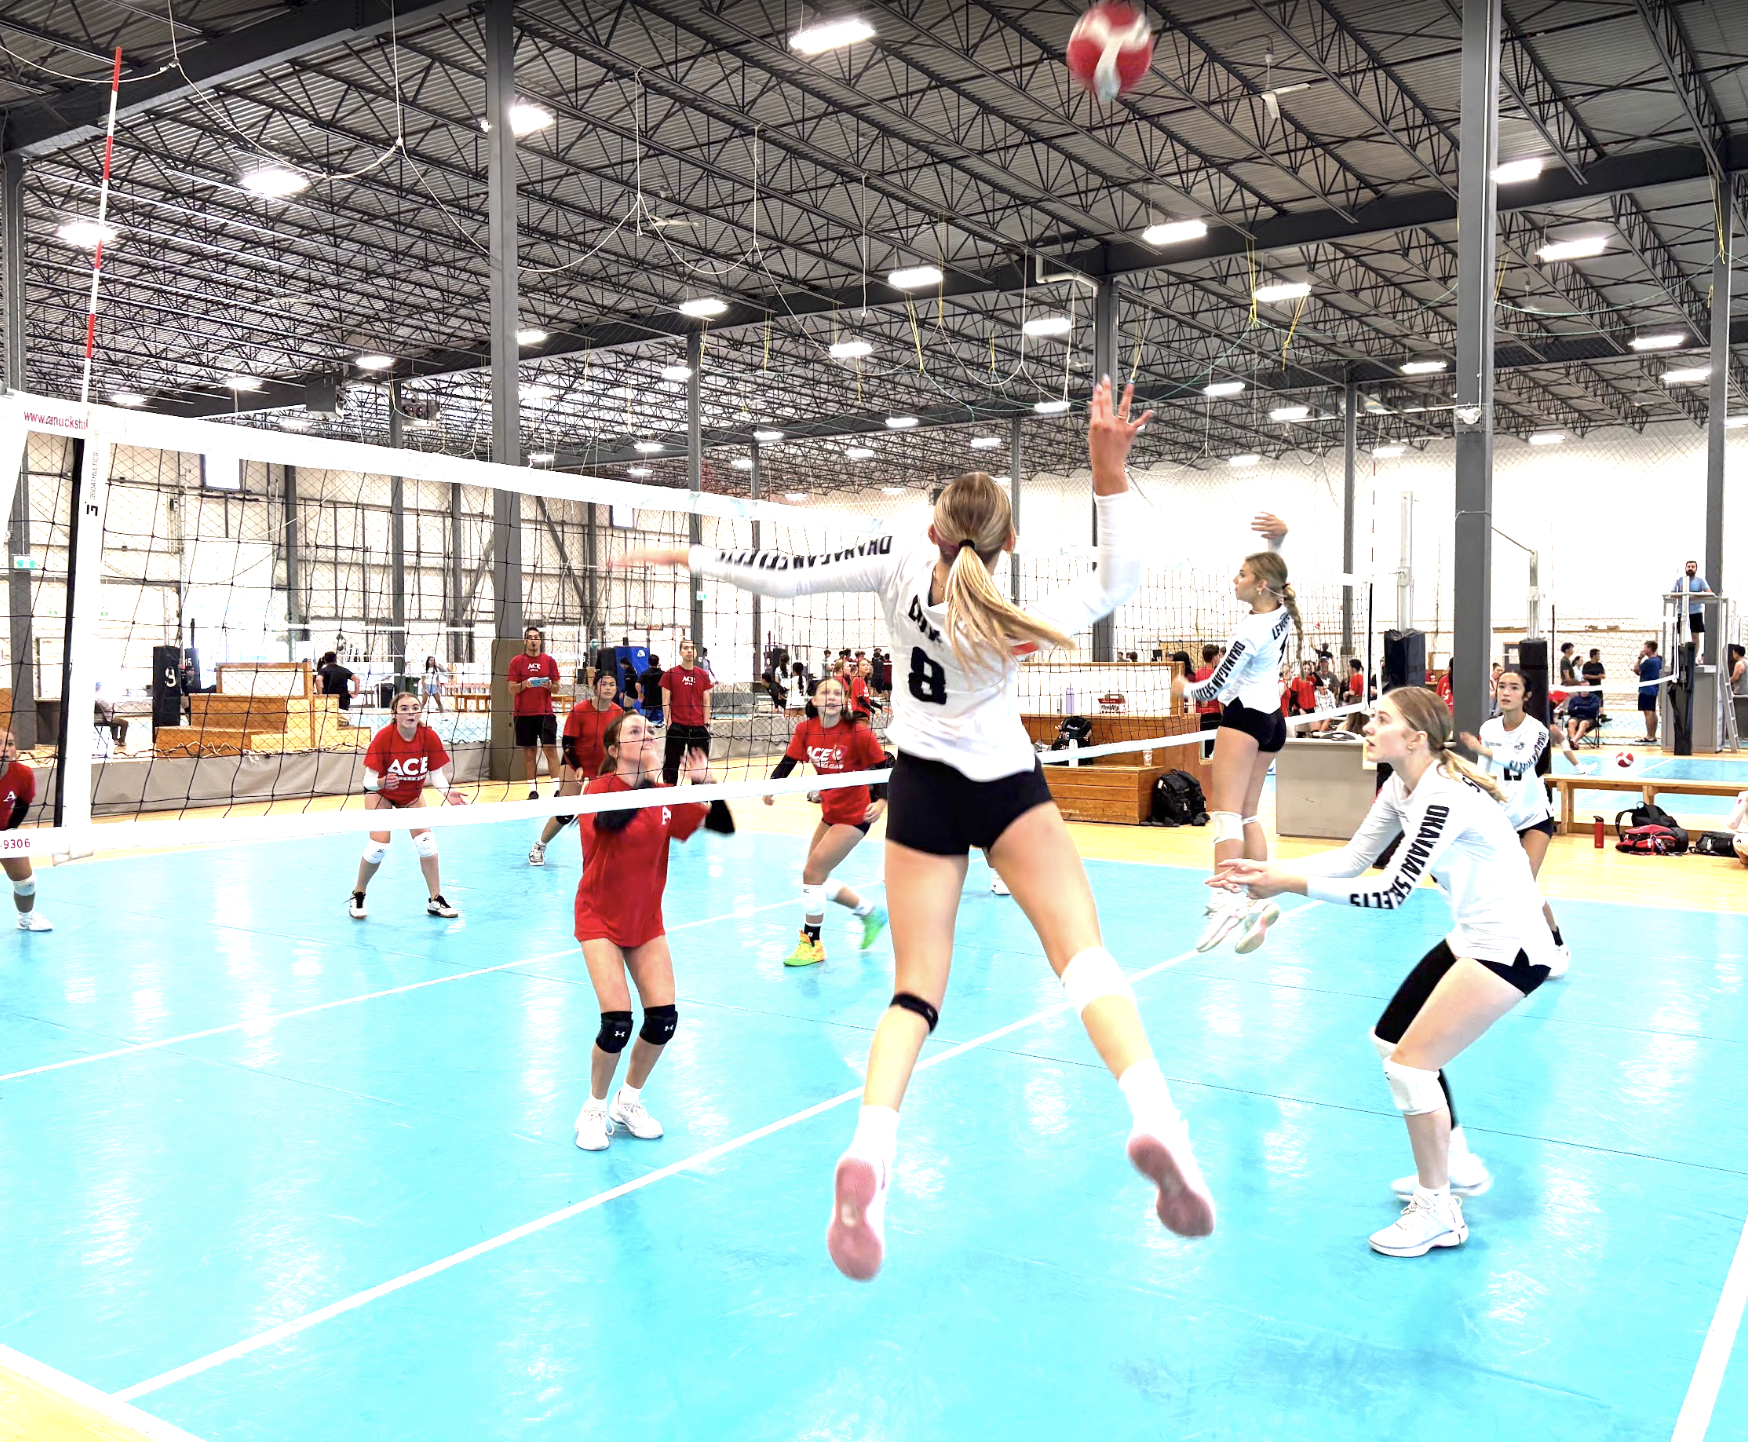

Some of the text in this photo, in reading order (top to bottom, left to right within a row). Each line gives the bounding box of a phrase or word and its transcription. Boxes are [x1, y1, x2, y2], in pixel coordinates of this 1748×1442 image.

[164, 666, 177, 688] 9
[908, 646, 947, 705] 8
[807, 745, 833, 761] ACE
[388, 756, 428, 776] ACE
